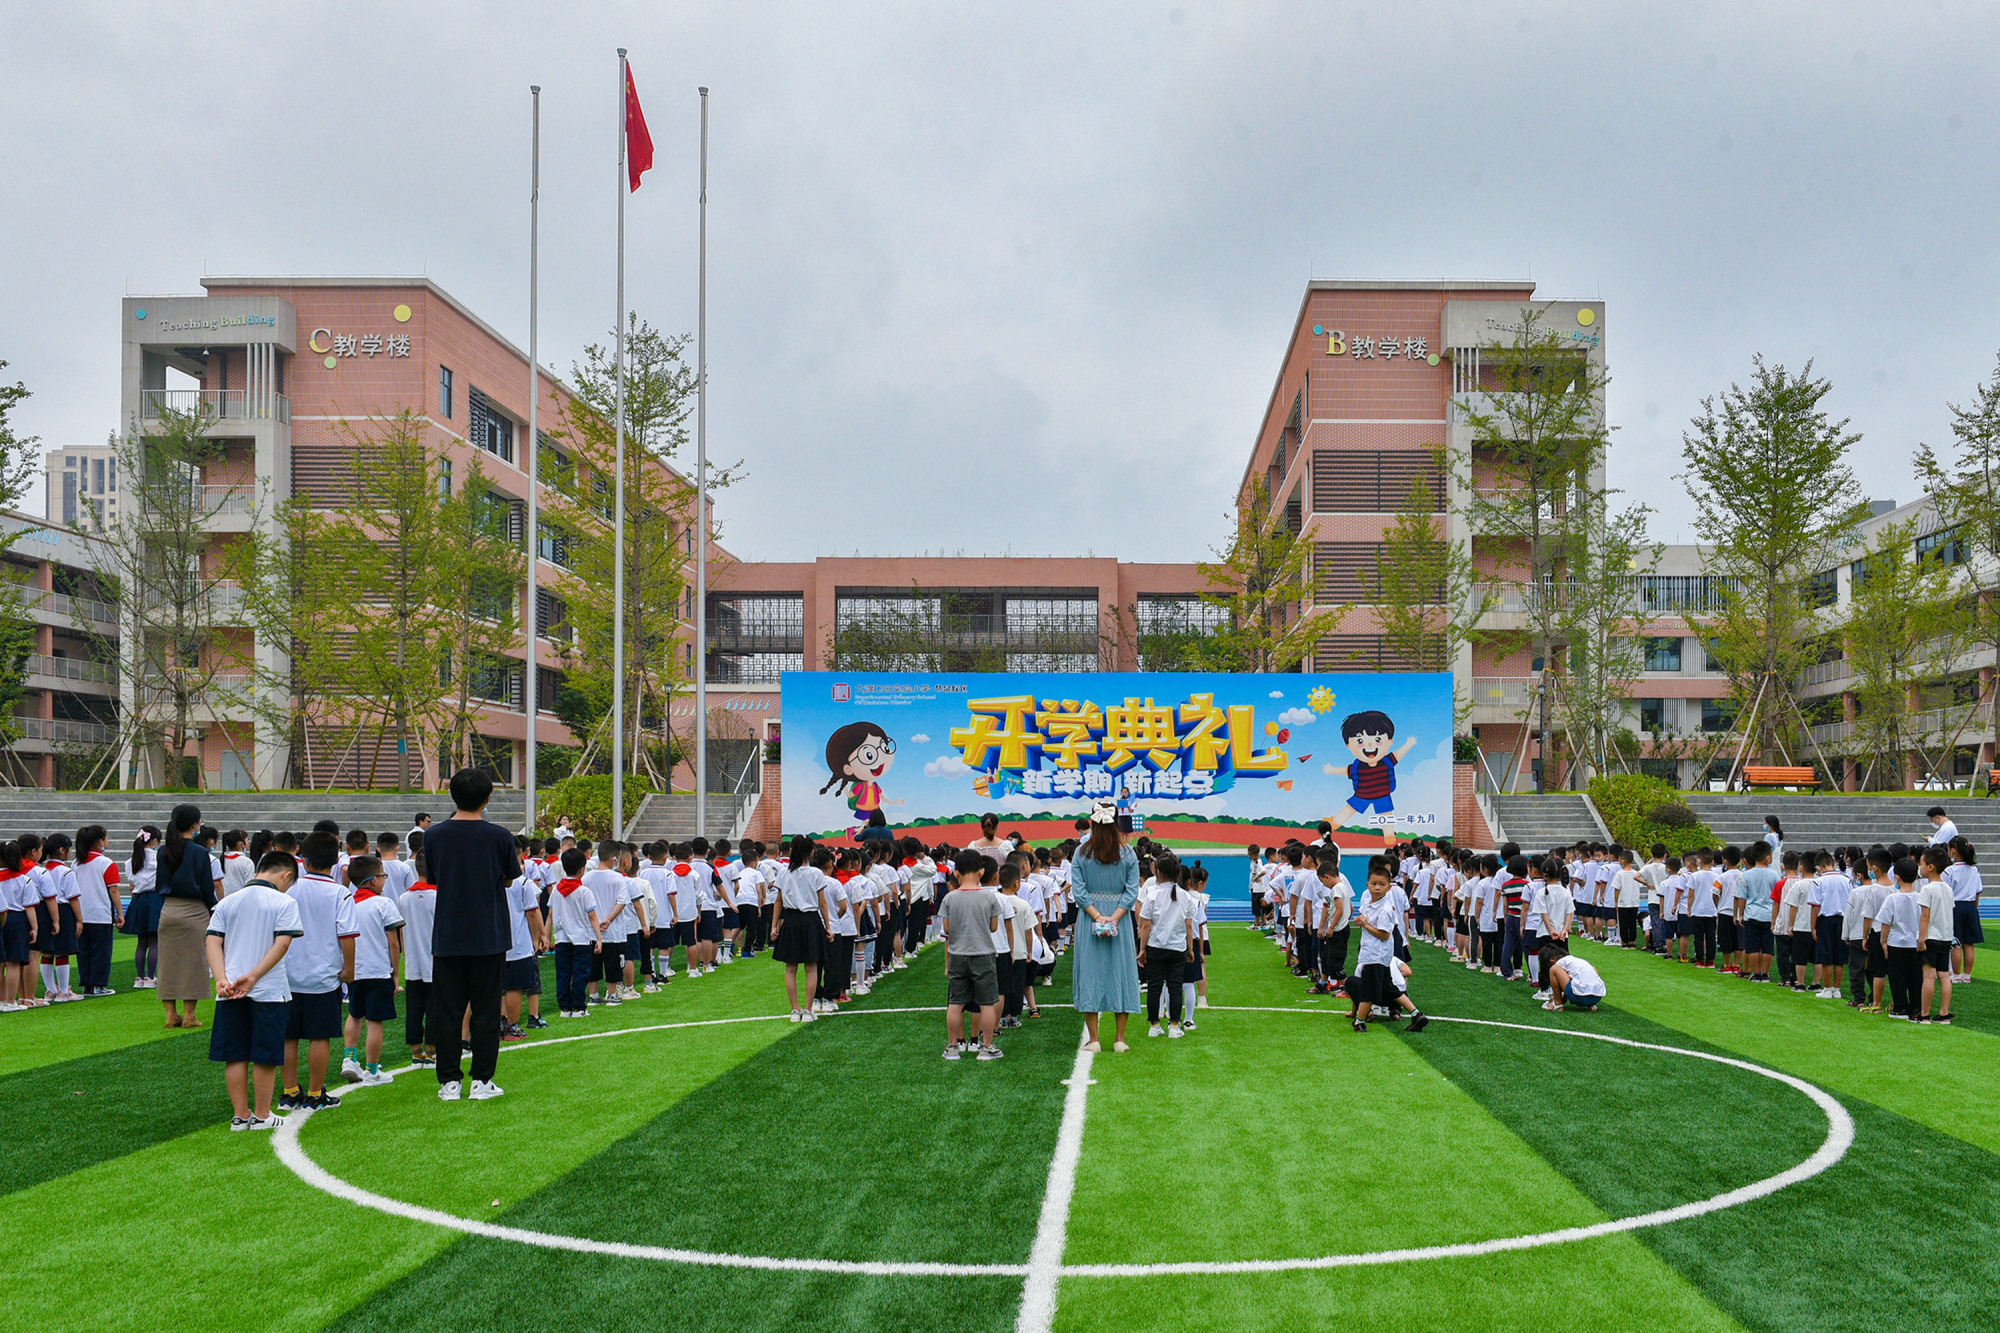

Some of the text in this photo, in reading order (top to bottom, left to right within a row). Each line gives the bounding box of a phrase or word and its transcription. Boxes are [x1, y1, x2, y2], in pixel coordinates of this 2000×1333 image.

[160, 314, 276, 332] Teaching Building
[950, 692, 1290, 772] 开学典礼
[1022, 769, 1215, 794] 新学期 新起点
